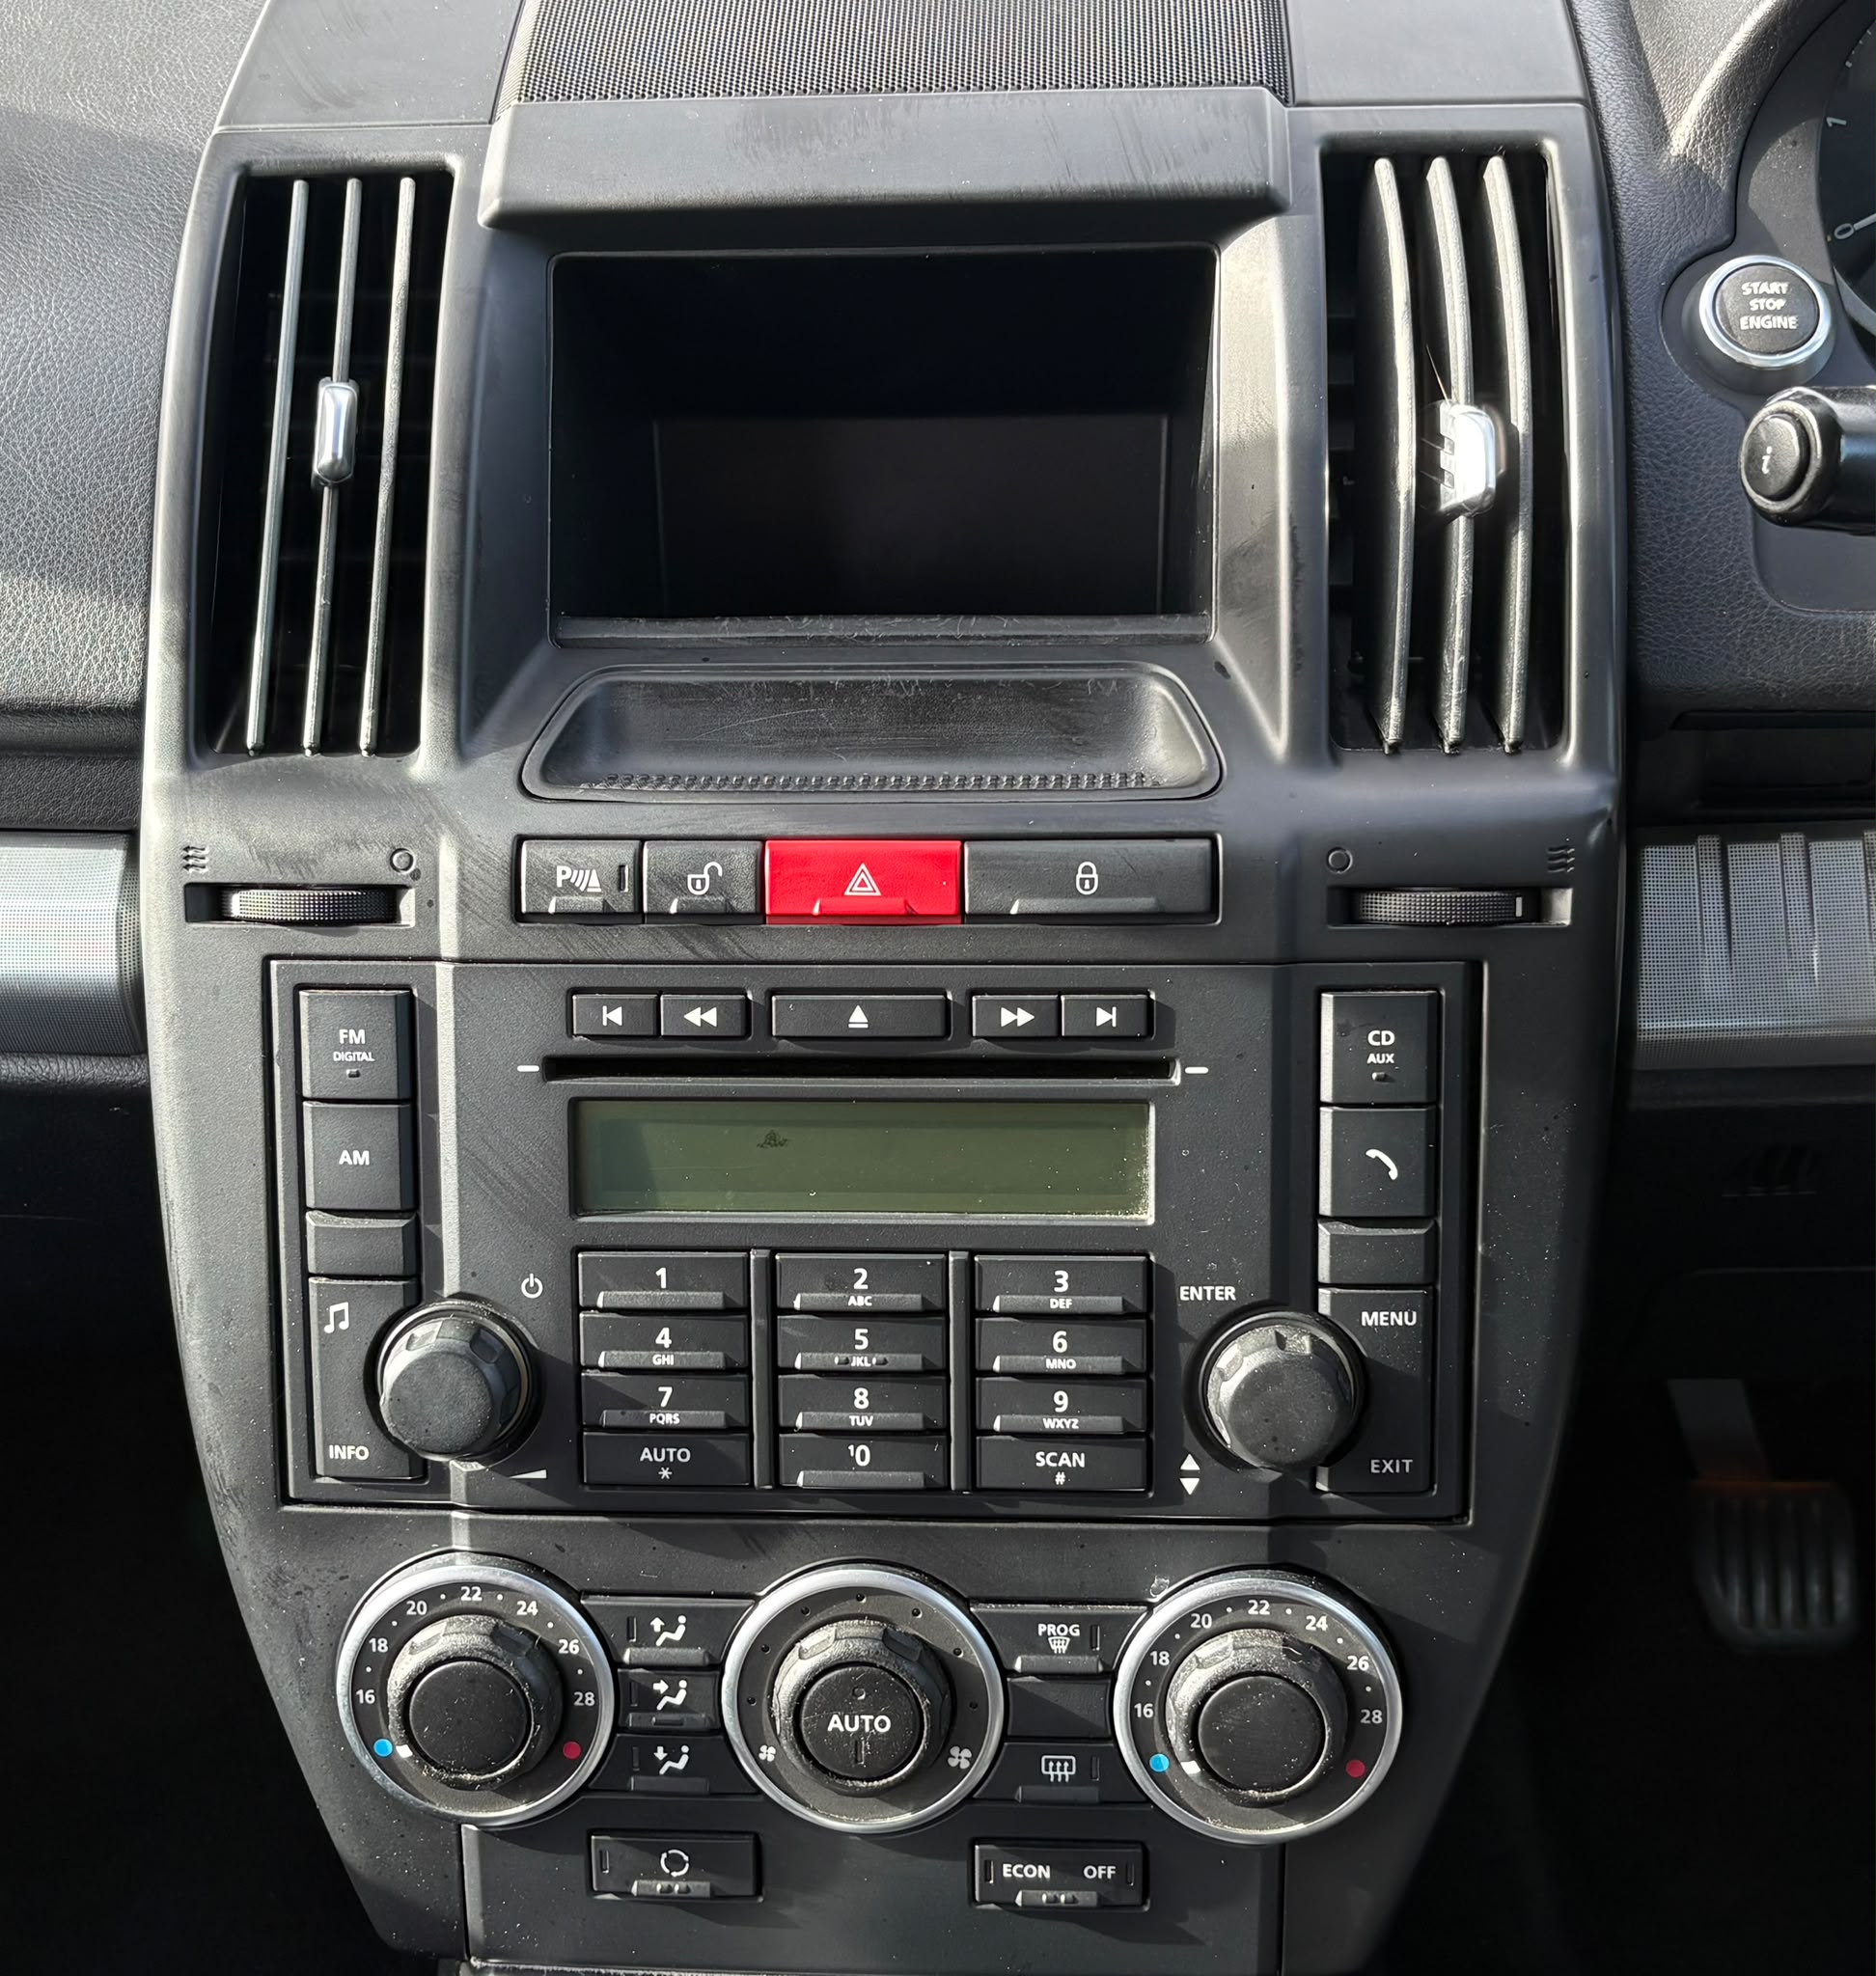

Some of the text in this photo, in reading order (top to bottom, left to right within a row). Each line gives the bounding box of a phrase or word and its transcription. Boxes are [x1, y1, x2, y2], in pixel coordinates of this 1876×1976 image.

[1826, 116, 1847, 126] 1
[1835, 223, 1855, 239] 0
[1741, 281, 1788, 295] START
[1750, 298, 1785, 311] STOP
[1740, 316, 1797, 330] ENGINE
[1762, 446, 1773, 474] i
[557, 866, 570, 887] P
[339, 1029, 366, 1044] FM
[1367, 1030, 1394, 1046] CD
[332, 1051, 374, 1062] DIGITAL
[1367, 1053, 1394, 1064] AUX
[338, 1150, 370, 1166] AM
[655, 1268, 668, 1289] 1
[853, 1269, 869, 1289] 2
[1054, 1271, 1068, 1292] 3
[847, 1296, 872, 1306] ABC
[1179, 1286, 1236, 1302] ENTER
[1050, 1299, 1072, 1308] DEF
[1361, 1311, 1417, 1327] MENU
[655, 1328, 672, 1348] 4
[854, 1329, 869, 1349] 5
[1053, 1331, 1067, 1353] 6
[652, 1355, 675, 1365] GHI
[850, 1357, 871, 1367] JKL
[1045, 1358, 1076, 1369] MNO
[658, 1386, 673, 1407] 7
[854, 1388, 869, 1409] 8
[1054, 1391, 1068, 1412] 9
[648, 1413, 679, 1426] PQRS
[848, 1415, 873, 1426] TUV
[1043, 1418, 1079, 1429] WXYZ
[329, 1444, 370, 1461] INFO
[640, 1447, 691, 1463] AUTO
[1035, 1451, 1085, 1468] SCAN
[1370, 1459, 1413, 1474] EXIT
[460, 1585, 483, 1602] 22
[406, 1601, 428, 1616] 20
[516, 1601, 538, 1617] 24
[1248, 1600, 1270, 1615] 22
[1191, 1613, 1212, 1630] 20
[1306, 1615, 1327, 1632] 24
[1037, 1623, 1080, 1637] PROG
[370, 1637, 388, 1653] 18
[558, 1638, 579, 1655] 26
[1150, 1651, 1169, 1666] 18
[1347, 1655, 1368, 1671] 26
[356, 1688, 375, 1705] 16
[574, 1690, 594, 1707] 28
[1134, 1703, 1154, 1718] 16
[1360, 1709, 1382, 1724] 28
[827, 1715, 892, 1734] AUTO
[1002, 1864, 1117, 1880] ECON OFF
